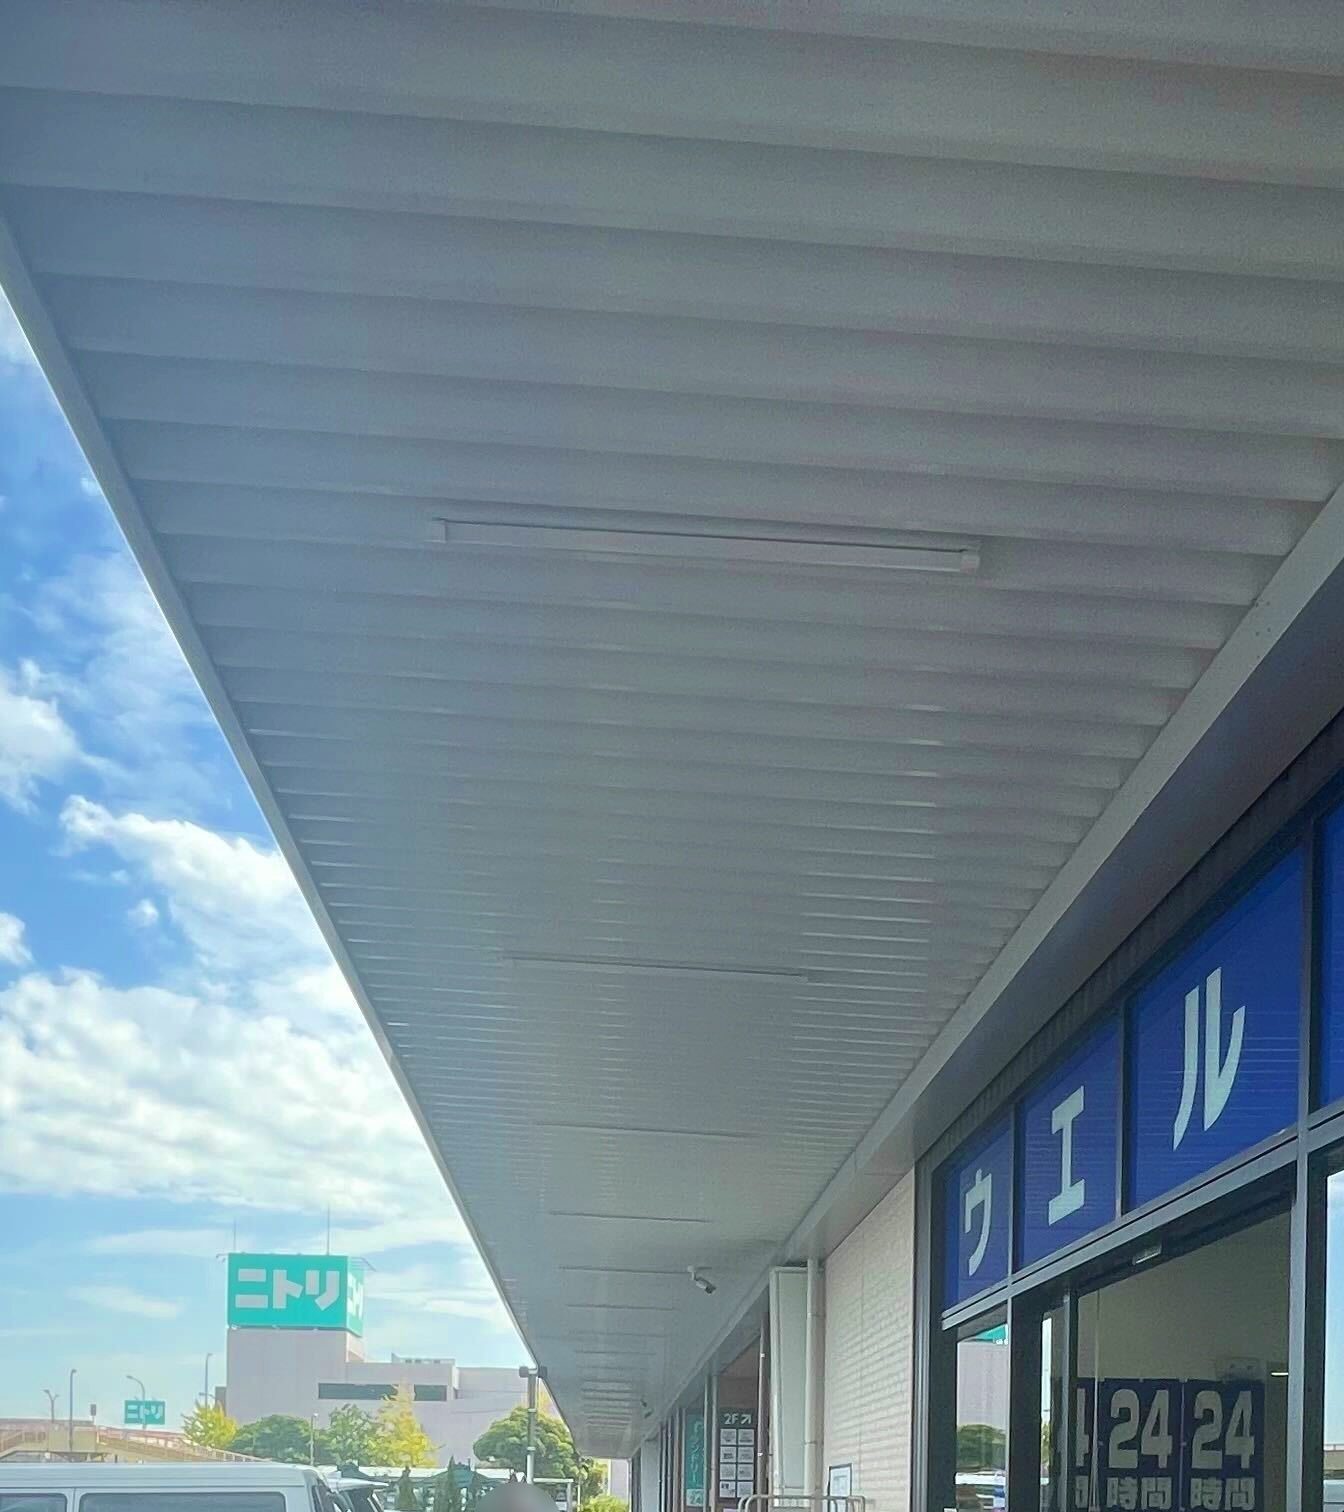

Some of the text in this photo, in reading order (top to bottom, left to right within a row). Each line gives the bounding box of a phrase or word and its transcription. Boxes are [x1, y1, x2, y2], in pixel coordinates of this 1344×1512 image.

[235, 1268, 340, 1311] ニトリ
[128, 1404, 163, 1420] ニトリ
[724, 1413, 738, 1425] 2F
[1109, 1389, 1172, 1469] 24
[1192, 1390, 1254, 1469] 24
[1107, 1477, 1172, 1511] 時間
[1190, 1477, 1255, 1511] 時間
